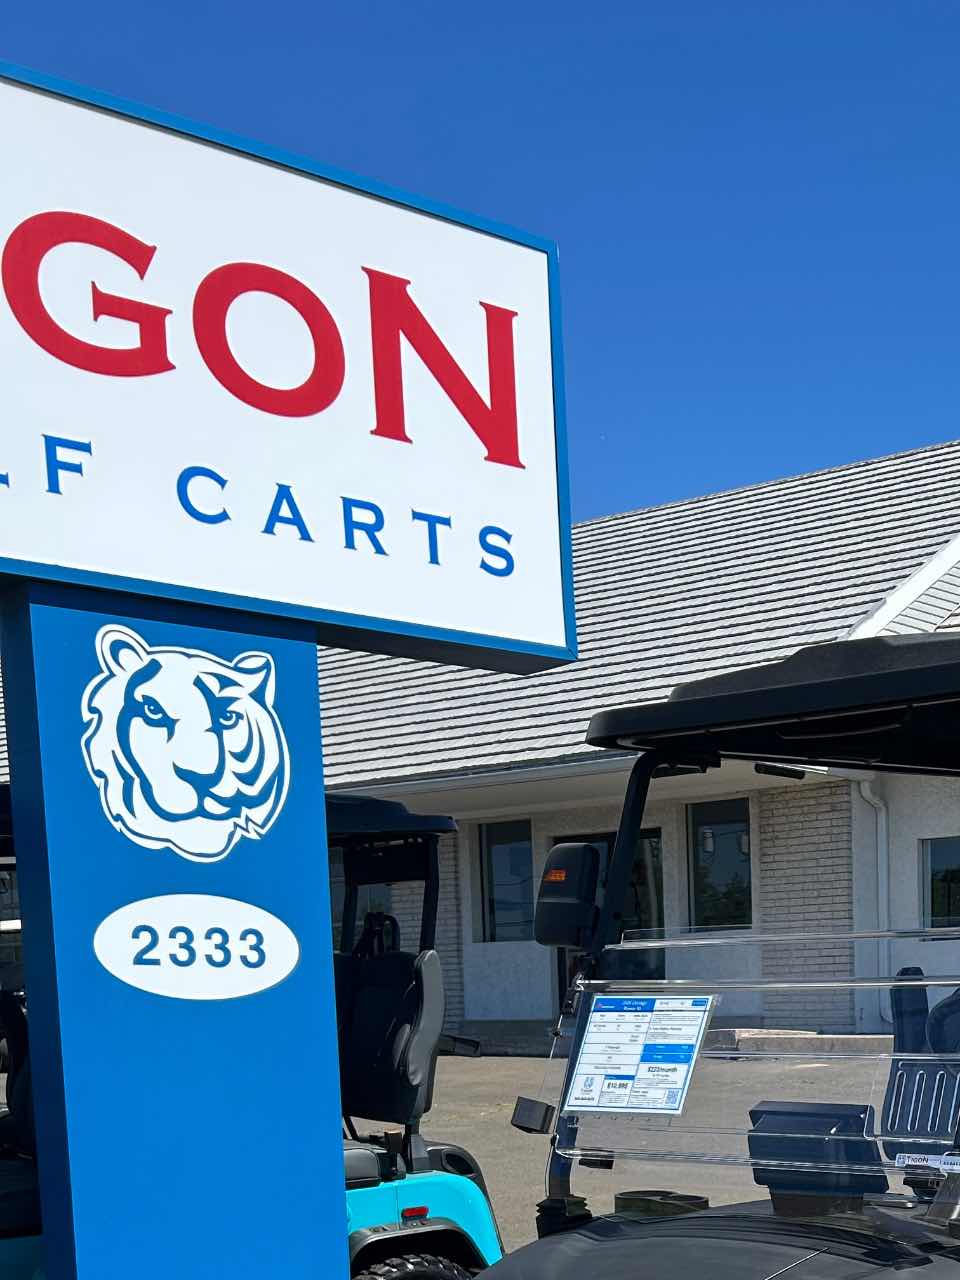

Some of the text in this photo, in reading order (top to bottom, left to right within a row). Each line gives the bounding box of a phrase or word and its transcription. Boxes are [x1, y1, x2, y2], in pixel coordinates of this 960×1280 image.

[0, 435, 516, 577] F CARTS
[131, 924, 267, 969] 2333
